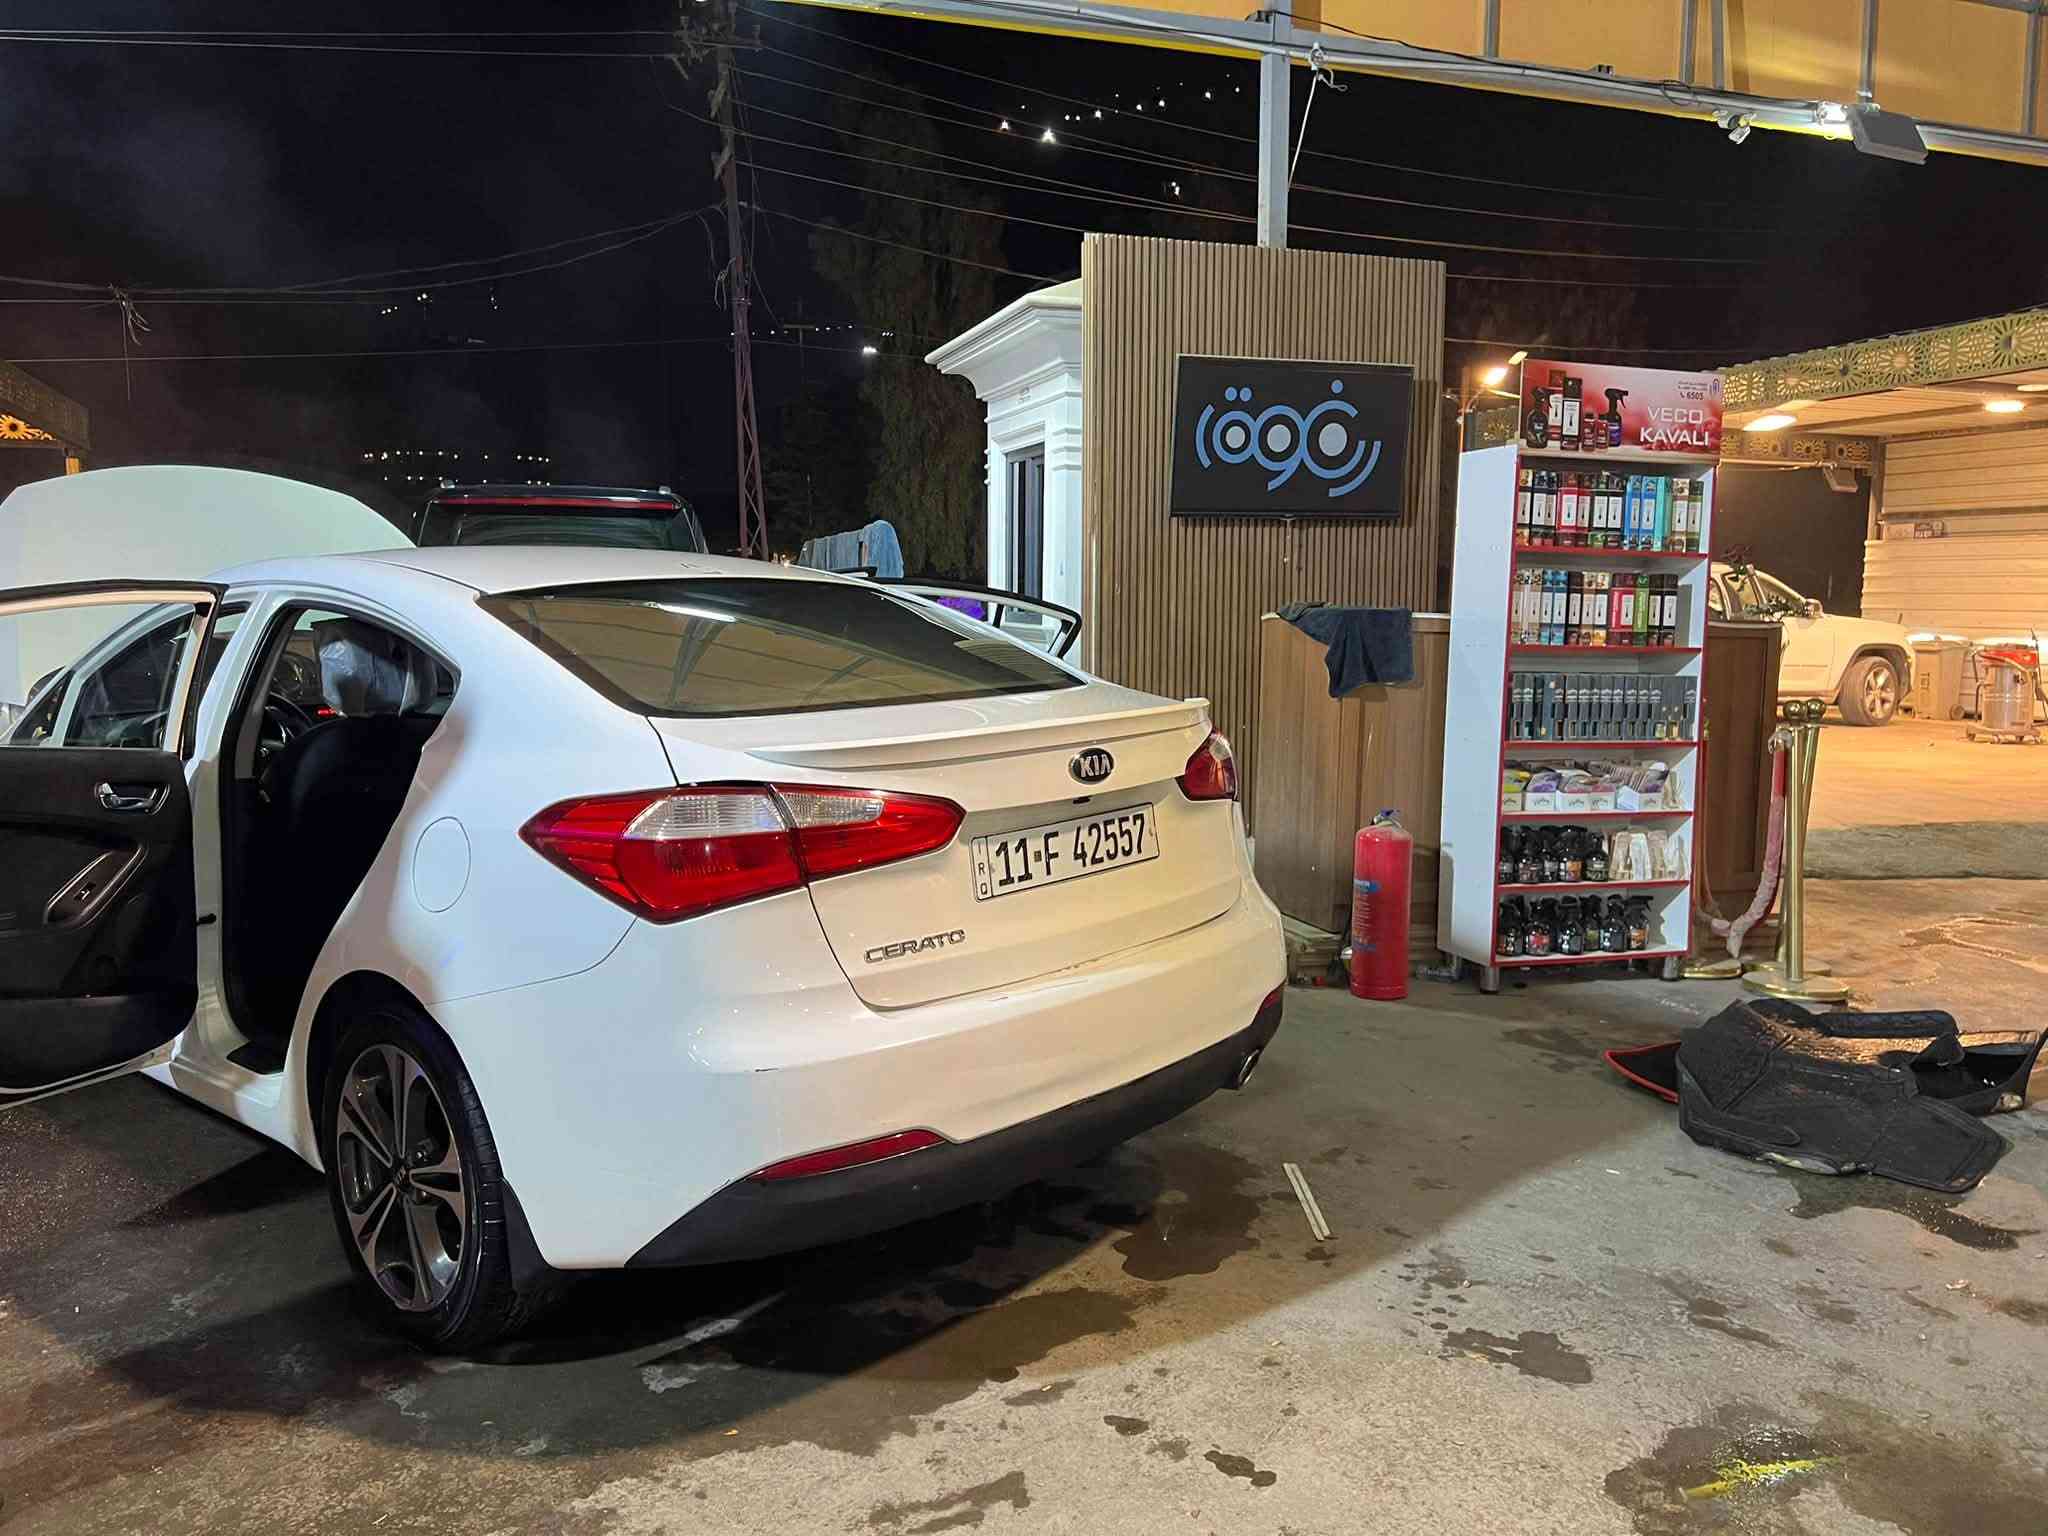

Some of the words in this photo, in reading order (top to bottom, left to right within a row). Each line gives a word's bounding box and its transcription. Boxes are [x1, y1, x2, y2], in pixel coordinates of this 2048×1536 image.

[1647, 406, 1704, 424] VECO
[1640, 427, 1709, 447] KAVALI
[1078, 756, 1114, 778] KIA
[1073, 812, 1146, 868] 42557
[864, 928, 966, 963] CERATO
